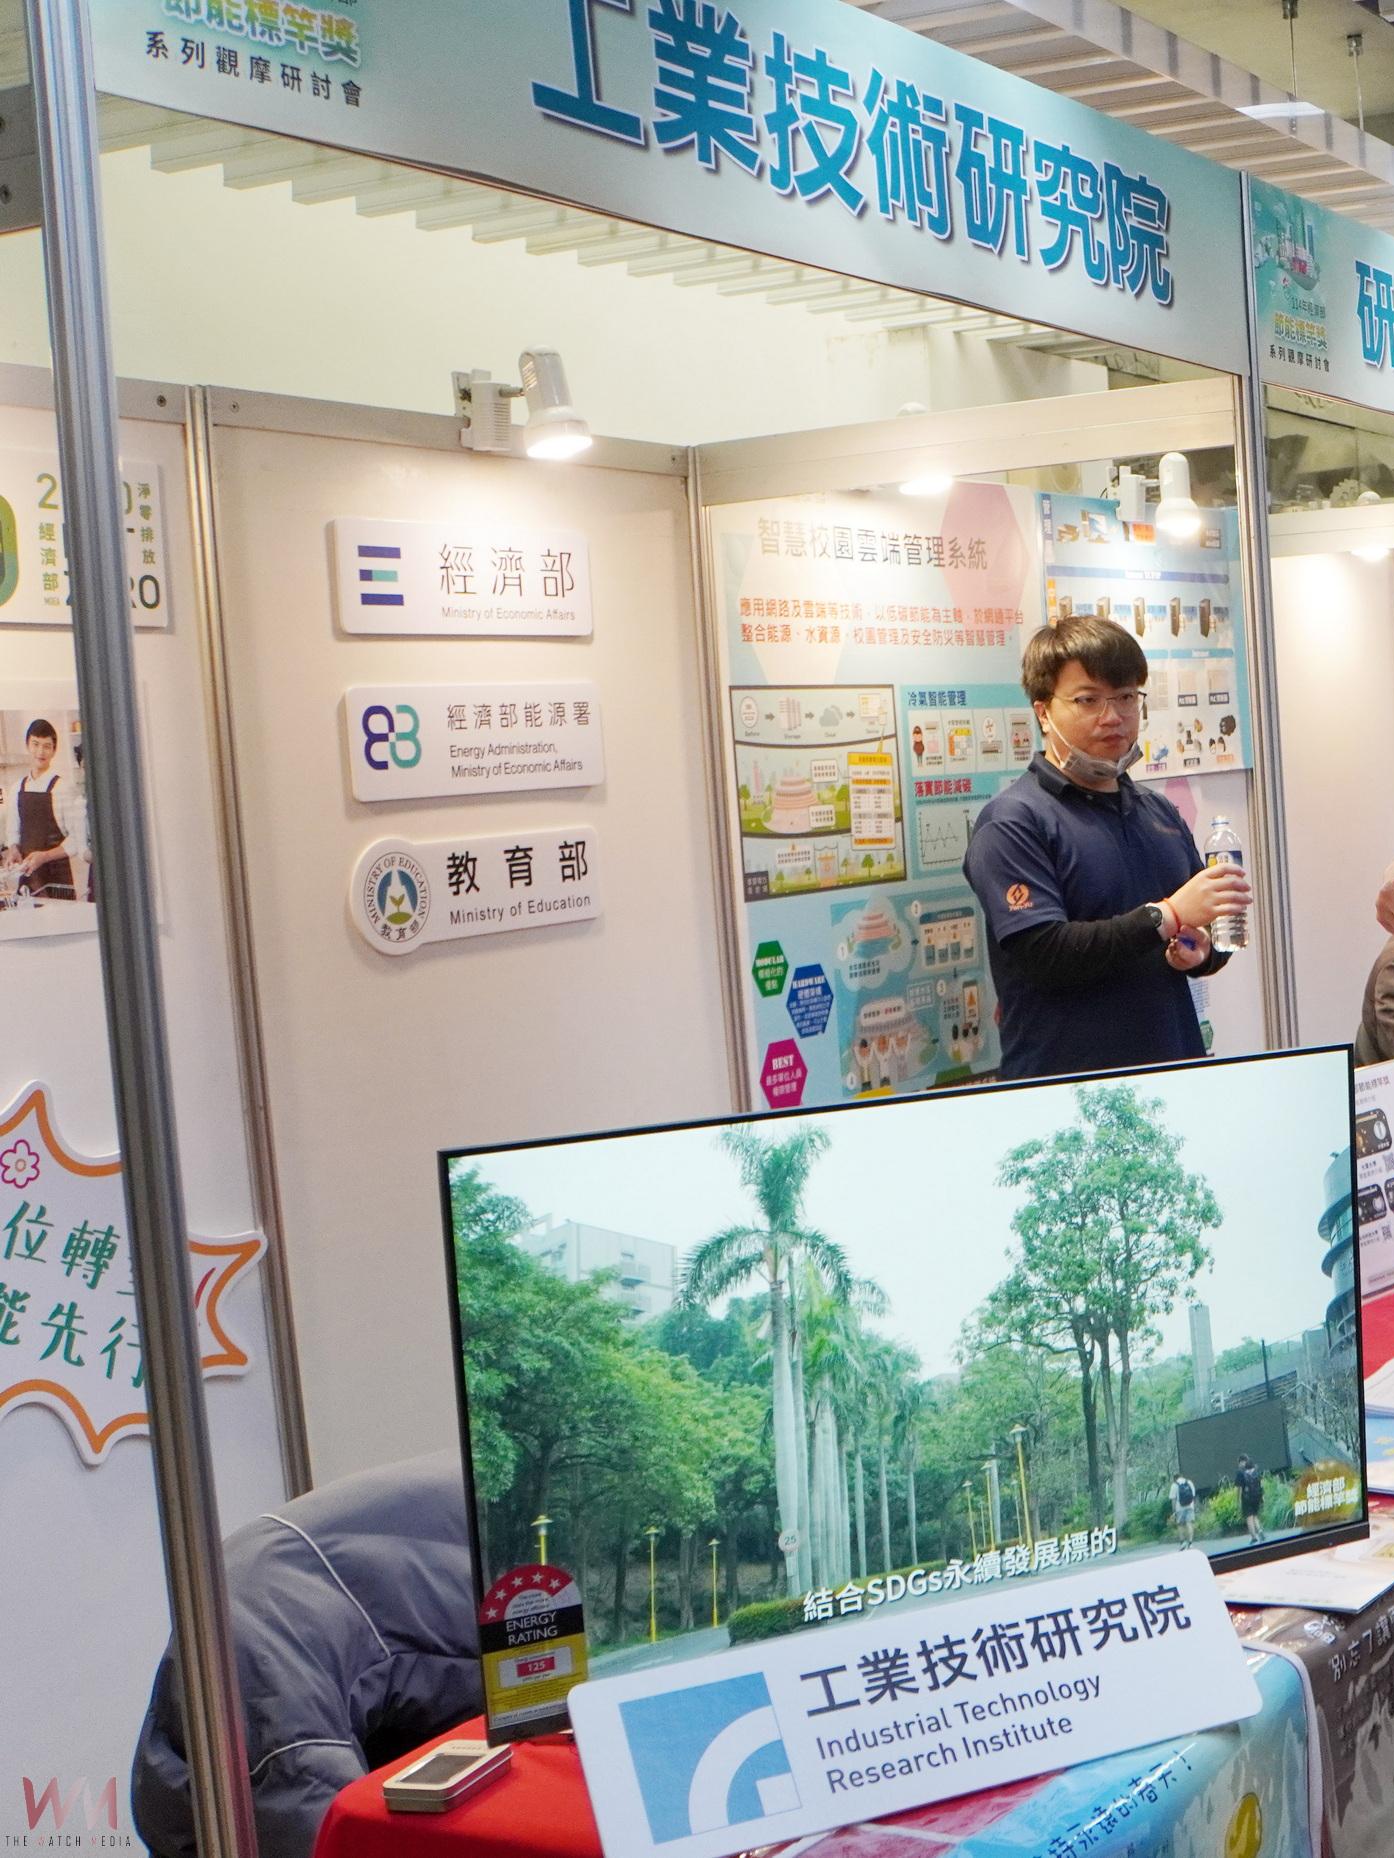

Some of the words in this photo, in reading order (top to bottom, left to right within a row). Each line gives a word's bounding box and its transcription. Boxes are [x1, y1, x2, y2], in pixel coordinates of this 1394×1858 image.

[145, 30, 363, 108] 系列觀摩研討會
[532, 0, 1172, 305] 工業技術研究院
[1269, 344, 1330, 372] 系列觀摩研討會
[439, 543, 575, 598] 經濟部
[441, 607, 482, 624] Ministry
[484, 608, 494, 620] of
[496, 608, 544, 620] Economic
[546, 608, 576, 621] Affairs
[447, 701, 591, 730] 經濟部能源署
[450, 745, 485, 759] Energy
[451, 765, 491, 779] Ministry
[493, 763, 502, 776] of
[504, 762, 551, 775] Economic
[553, 759, 583, 771] Affairs
[447, 840, 588, 896] 教育部
[450, 905, 504, 925] Ministry
[510, 902, 522, 917] of
[527, 895, 591, 914] Education
[802, 1526, 1118, 1624] 結合SDGs永續發展標的
[505, 1611, 557, 1632] ENERGY
[508, 1626, 558, 1646] RATING
[799, 1584, 1192, 1718] 工業技術研究院
[816, 1709, 952, 1760] Industrial
[959, 1674, 1102, 1726] Technology
[825, 1745, 959, 1794] Research
[965, 1714, 1074, 1759] Institute
